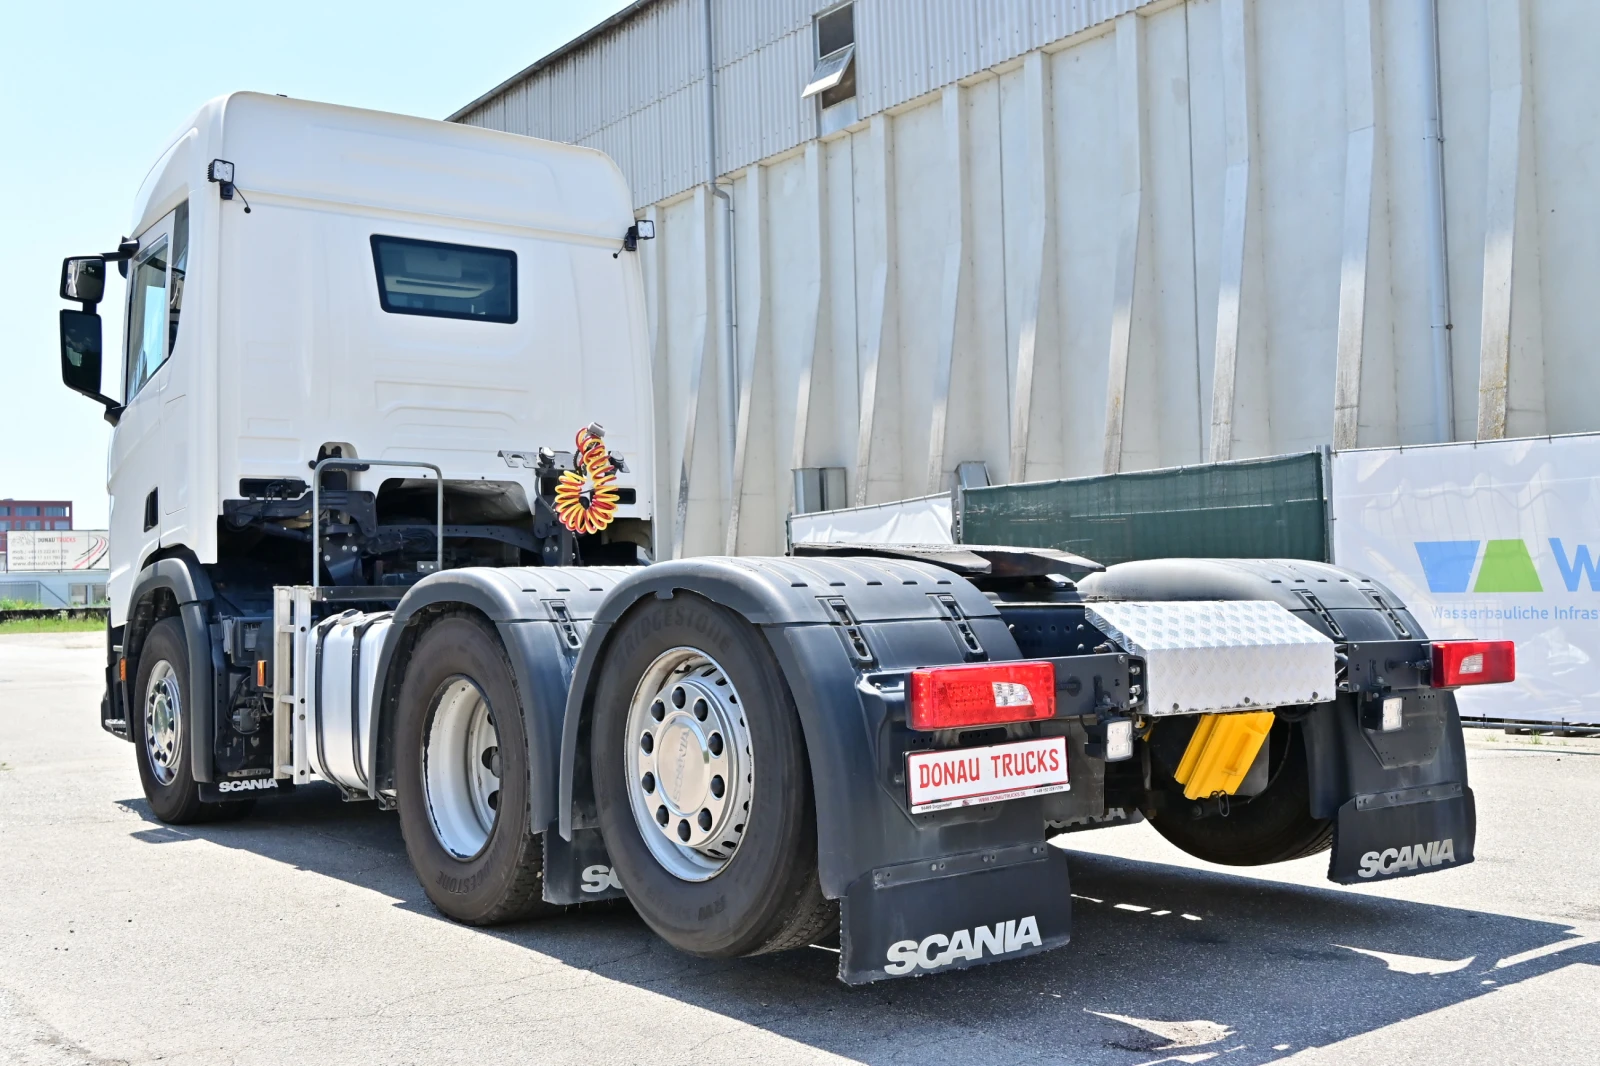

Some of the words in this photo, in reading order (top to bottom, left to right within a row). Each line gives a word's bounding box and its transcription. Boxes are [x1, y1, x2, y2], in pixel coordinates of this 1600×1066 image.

[1431, 606, 1548, 620] Wasserbauliche
[1554, 606, 1600, 620] Infras
[219, 778, 278, 792] SCANIA
[919, 757, 980, 788] DONAU
[991, 748, 1059, 778] TRUCKS
[1357, 839, 1456, 878] SCANIA
[884, 915, 1042, 975] SCANIA
